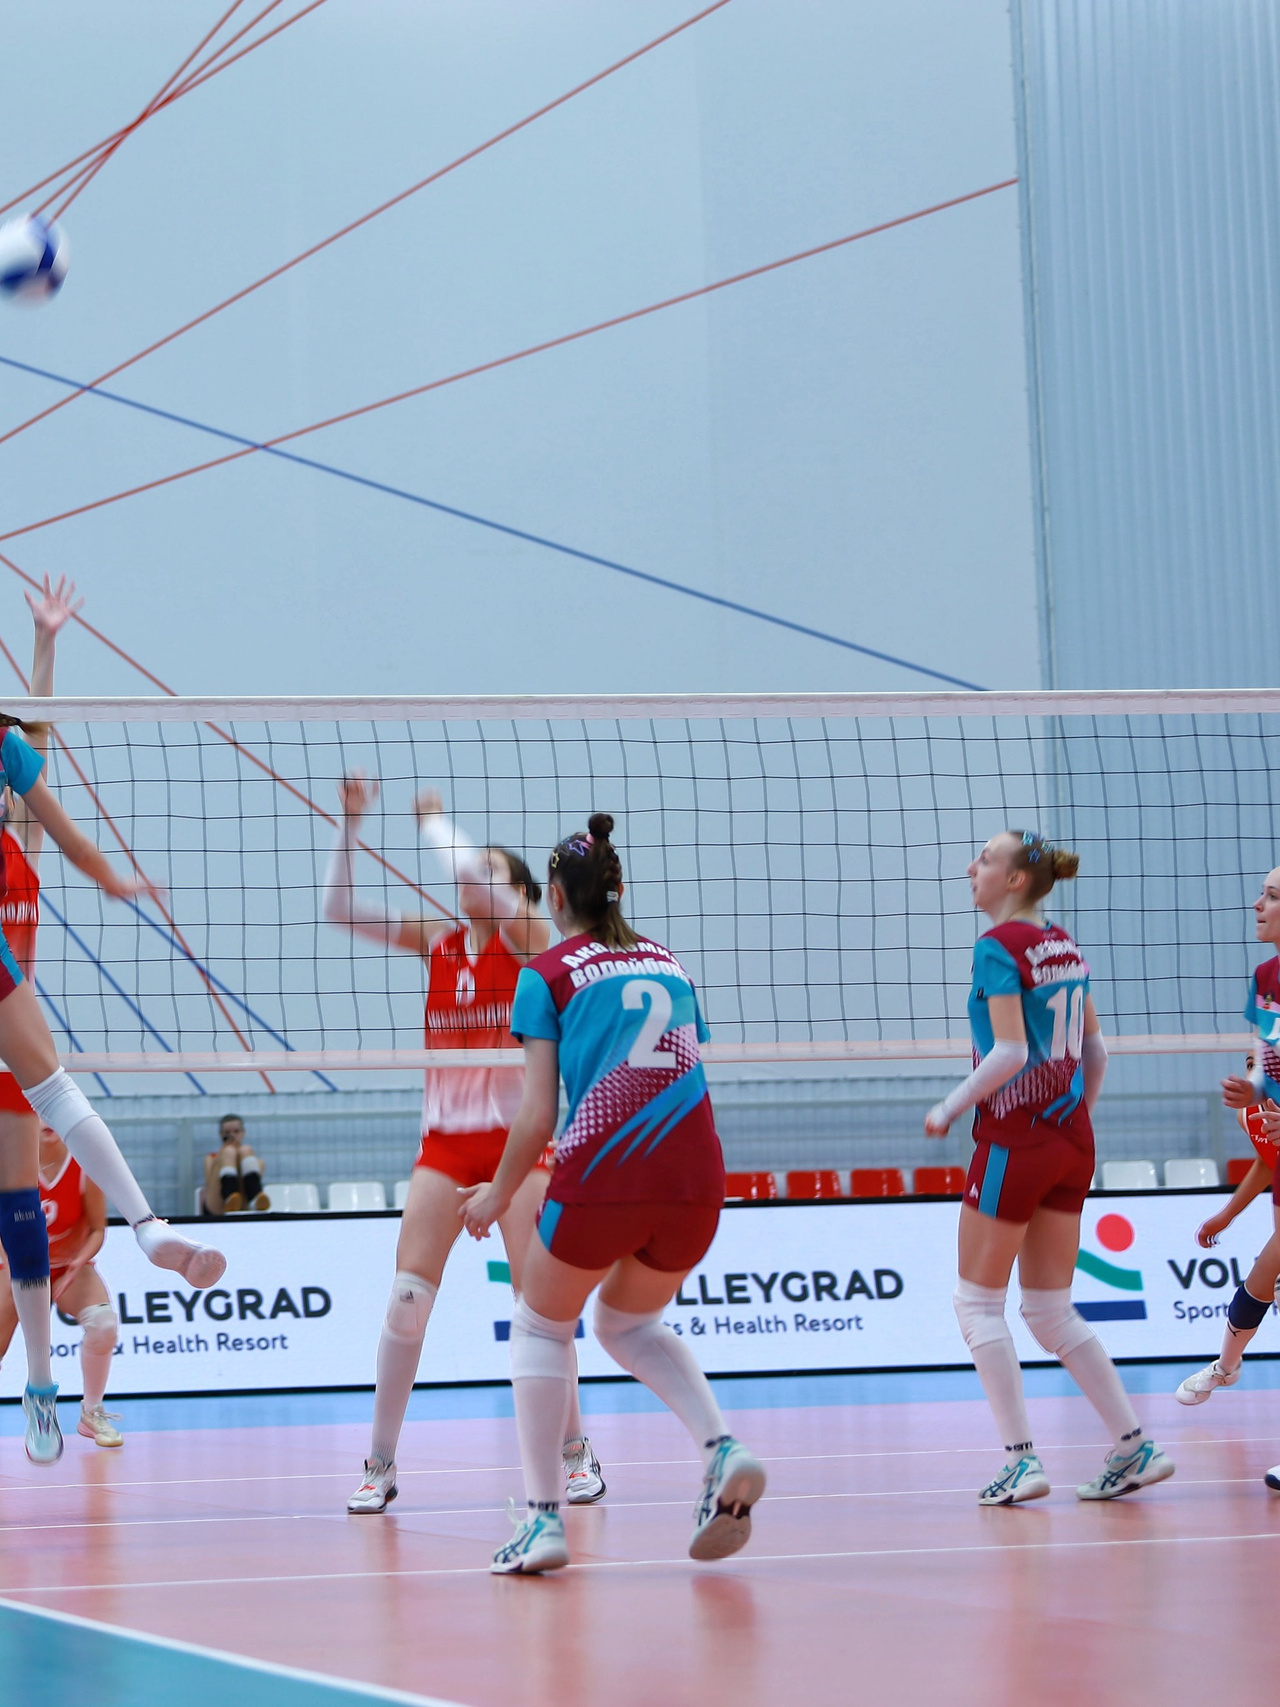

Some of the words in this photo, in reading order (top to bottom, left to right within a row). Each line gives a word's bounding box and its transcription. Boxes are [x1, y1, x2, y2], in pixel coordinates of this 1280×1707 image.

[621, 979, 678, 1069] 2
[1045, 984, 1085, 1062] 10
[690, 1316, 706, 1335] &
[714, 1315, 787, 1335] Health
[794, 1313, 864, 1332] Resort
[1173, 1300, 1230, 1324] Sport
[133, 1334, 208, 1354] Health
[216, 1332, 288, 1351] Resort
